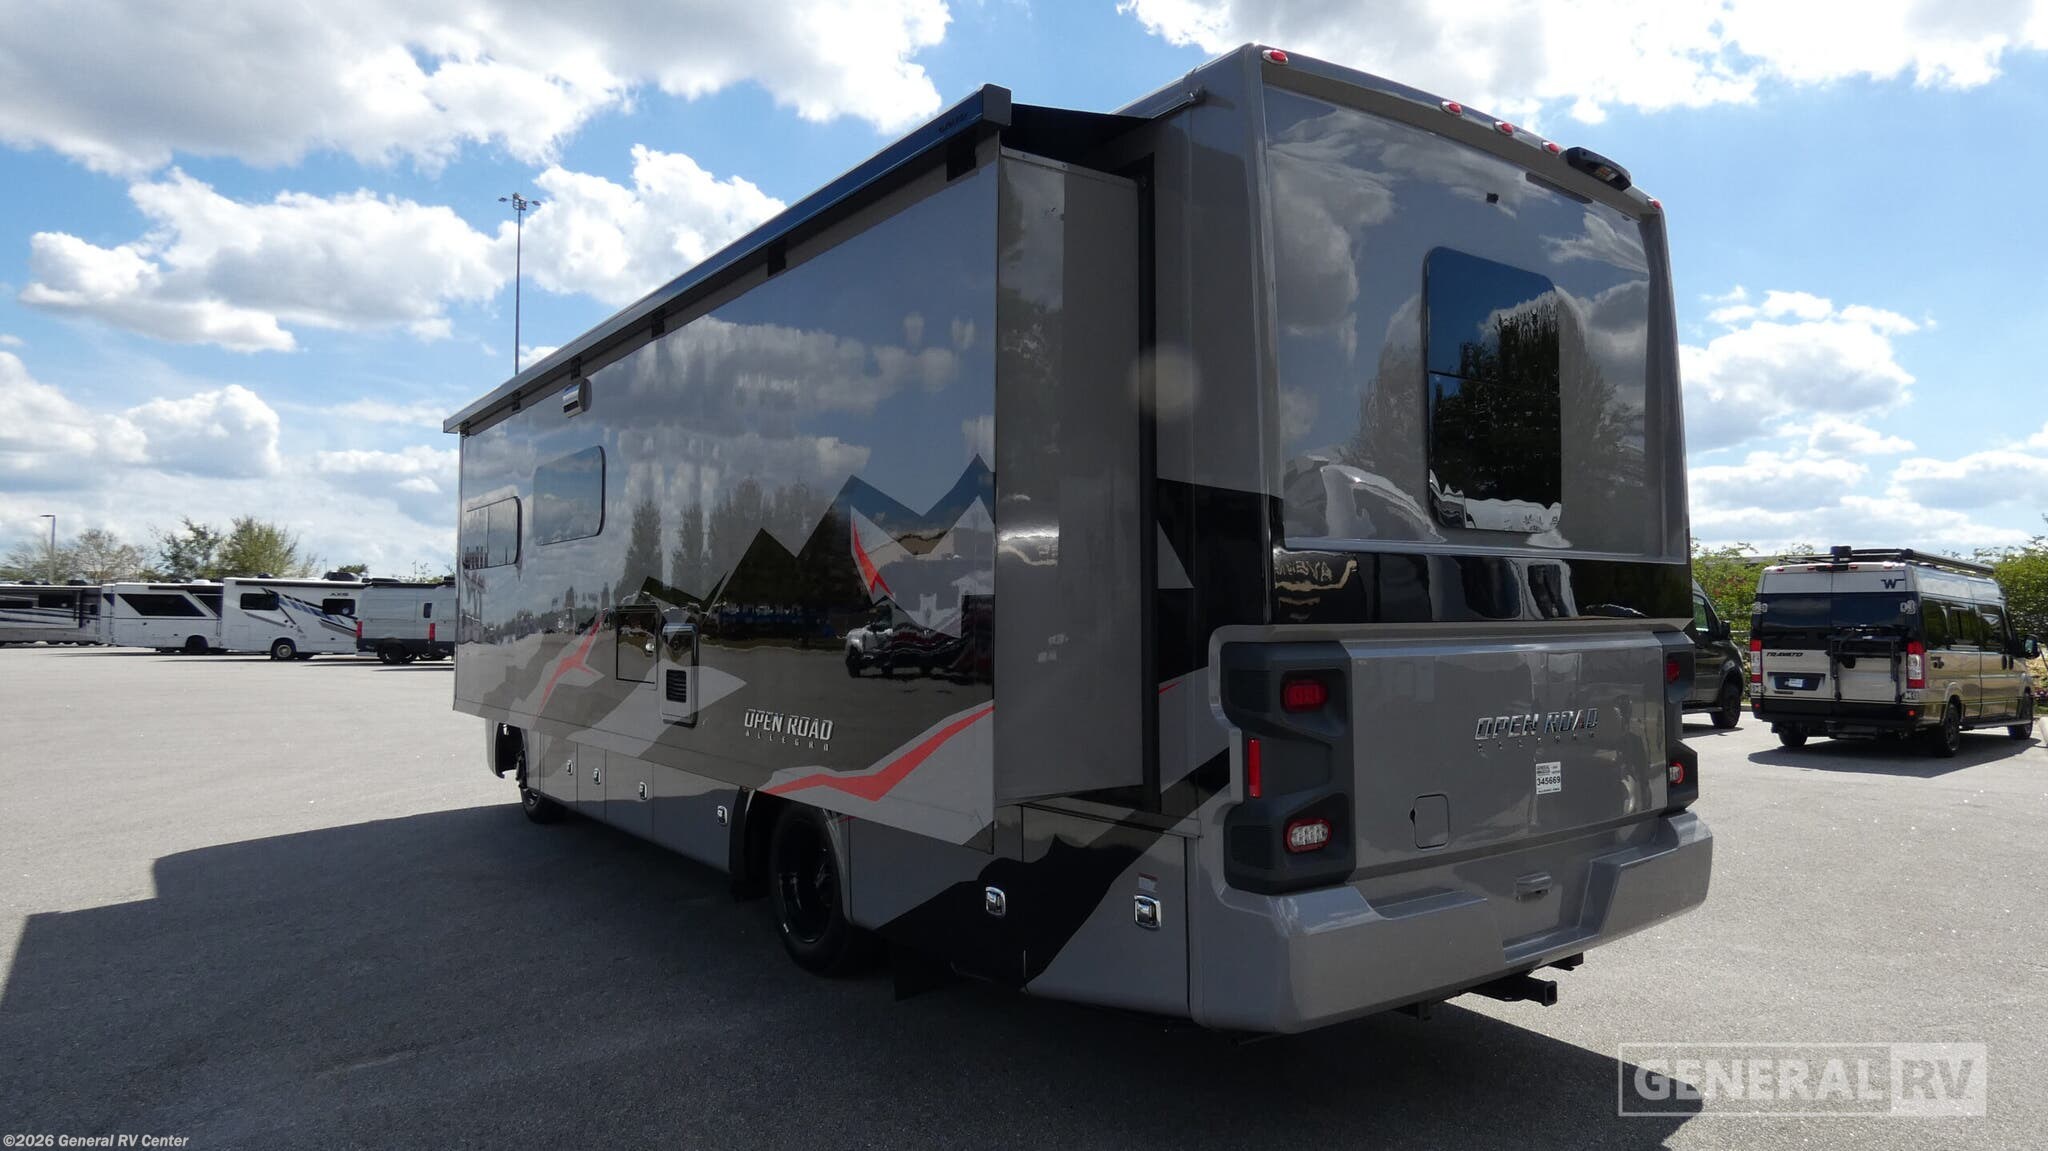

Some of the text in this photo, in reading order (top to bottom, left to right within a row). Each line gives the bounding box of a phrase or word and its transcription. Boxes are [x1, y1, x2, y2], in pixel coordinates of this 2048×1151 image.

[743, 708, 834, 741] OPEN ROAD
[1474, 707, 1599, 740] OPEN ROAD
[745, 730, 829, 752] ALLEGRO
[1536, 775, 1561, 786] 345669
